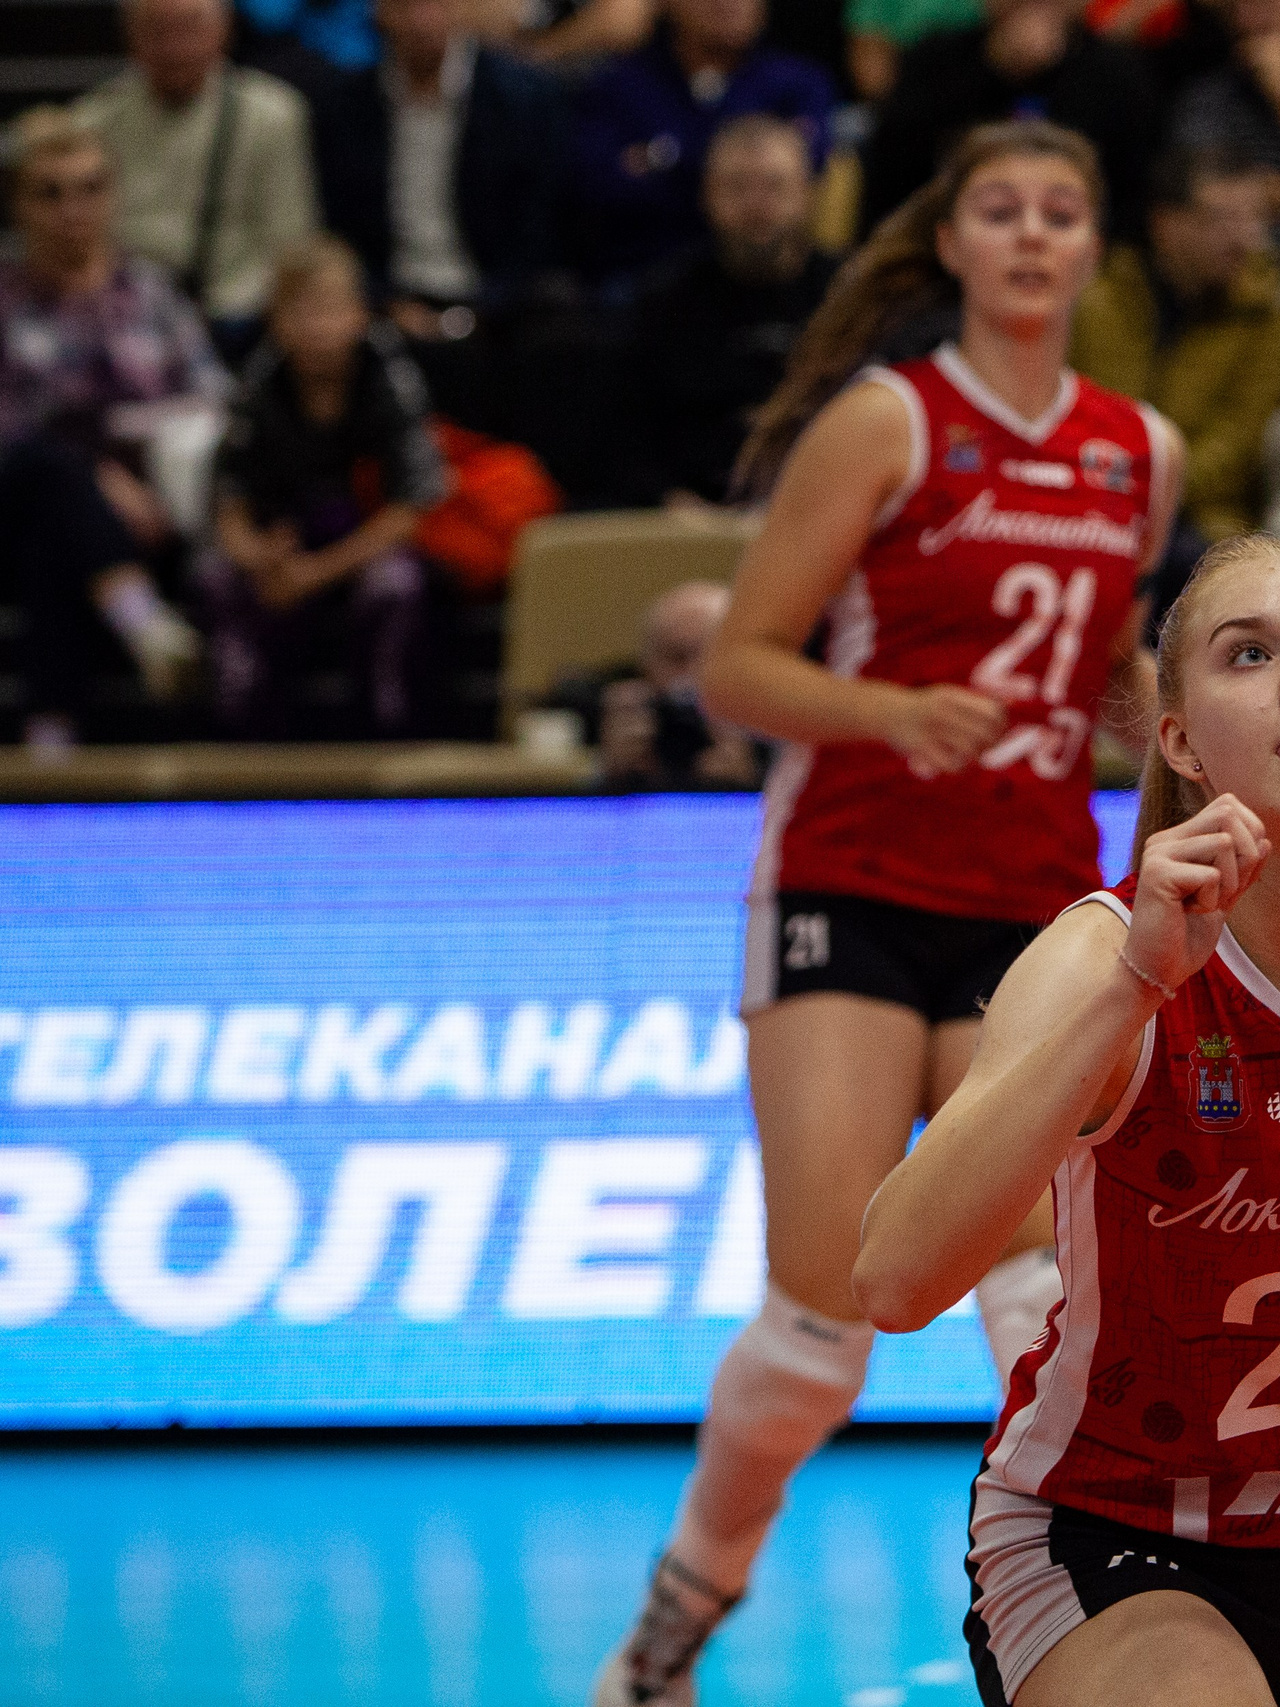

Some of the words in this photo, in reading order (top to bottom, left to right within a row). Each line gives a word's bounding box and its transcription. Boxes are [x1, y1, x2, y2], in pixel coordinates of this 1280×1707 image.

[969, 561, 1097, 704] 21
[784, 912, 830, 969] 21
[0, 1004, 748, 1103] ЕЛЕКАНА
